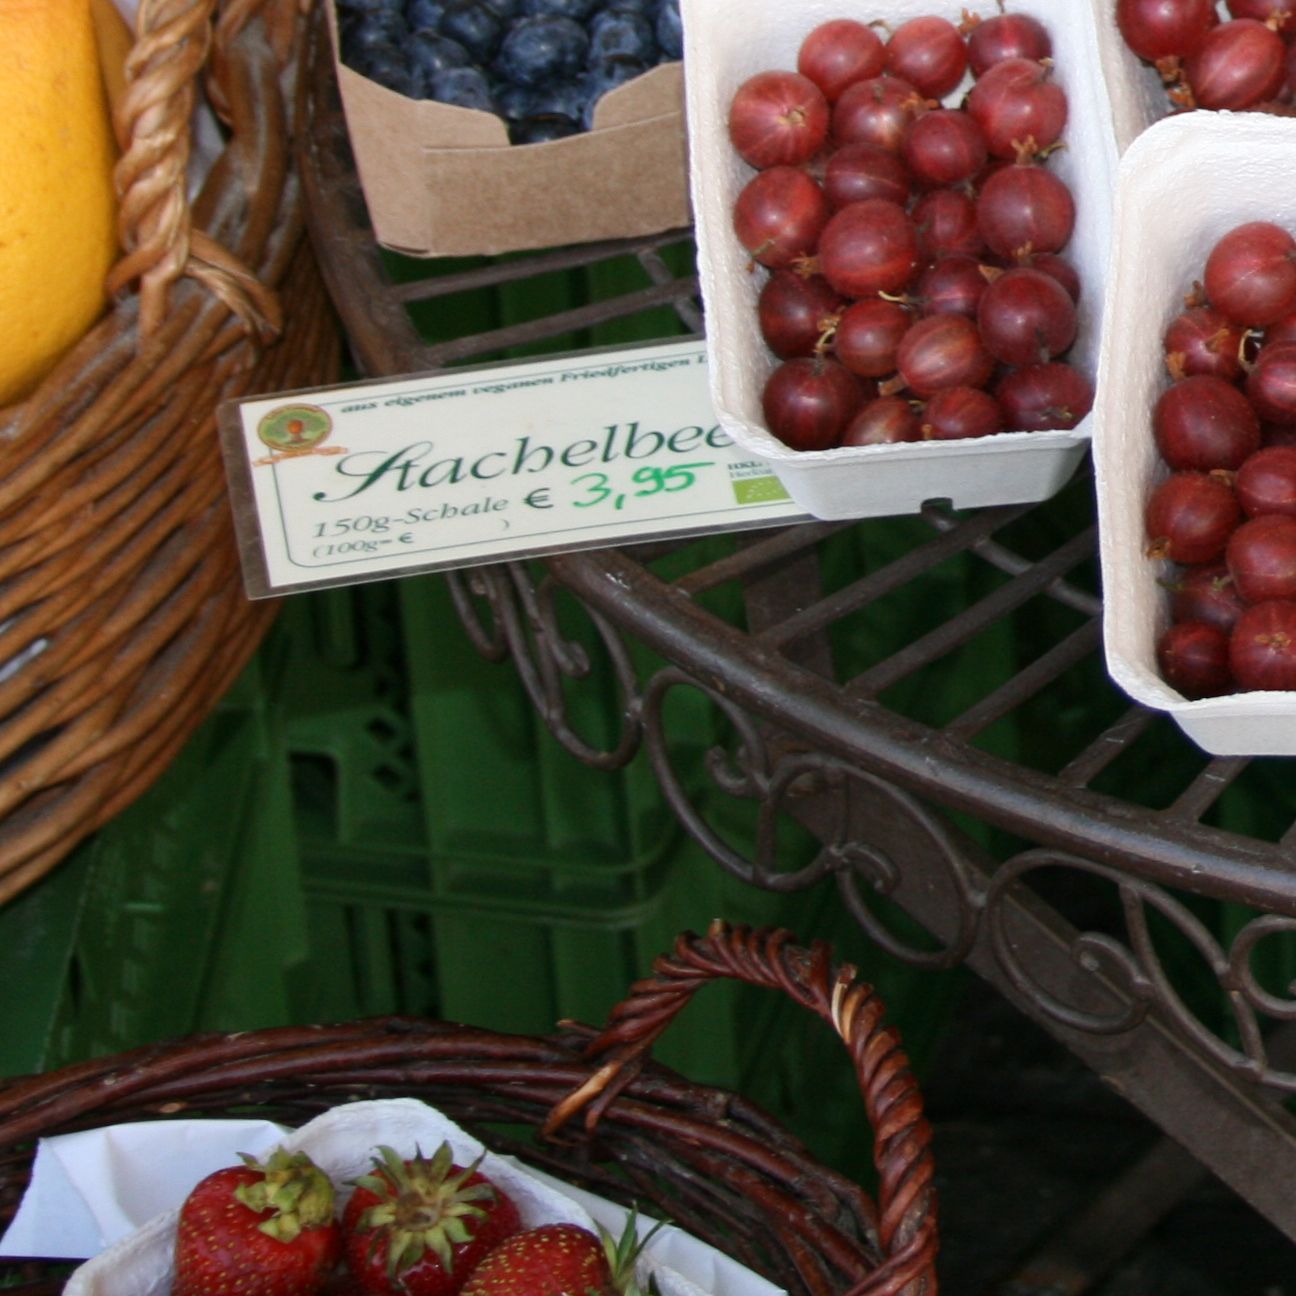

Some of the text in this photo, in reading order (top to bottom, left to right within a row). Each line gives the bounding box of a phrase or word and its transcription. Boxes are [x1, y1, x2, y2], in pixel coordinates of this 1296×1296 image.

[385, 389, 467, 407] eigenem
[473, 377, 554, 394] veganen
[560, 358, 691, 382] Friedfertigen
[313, 461, 716, 537] 150g-Schale € 3,95
